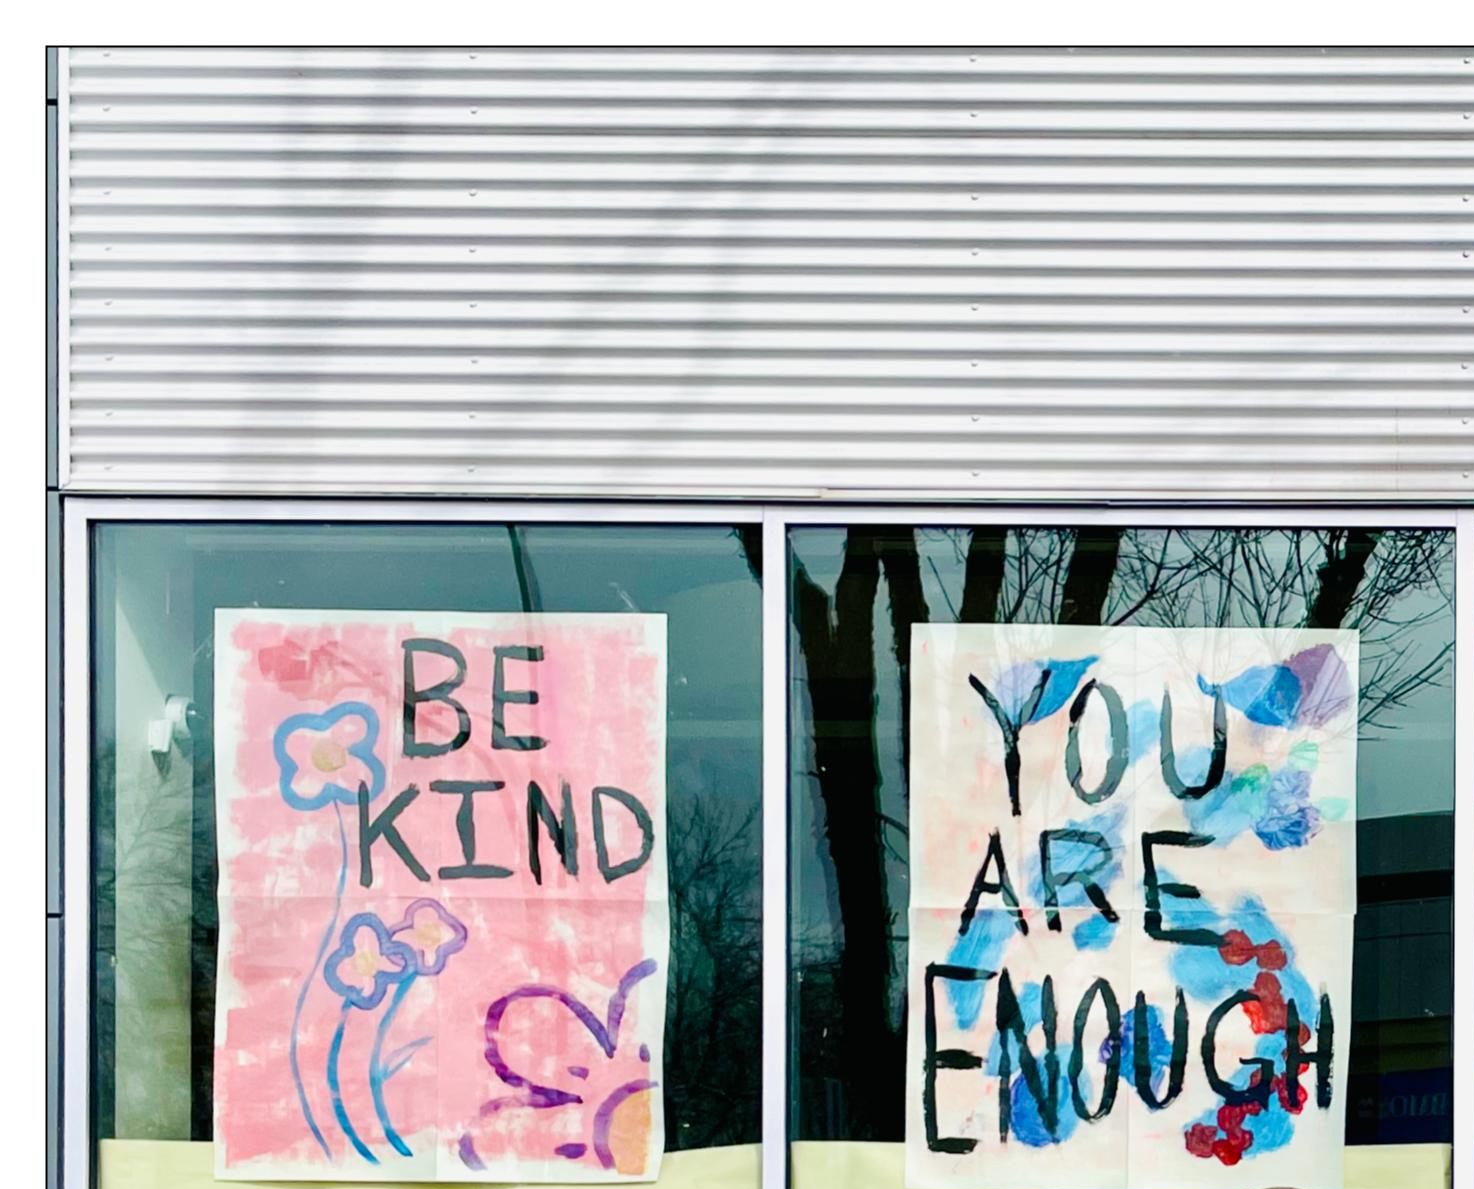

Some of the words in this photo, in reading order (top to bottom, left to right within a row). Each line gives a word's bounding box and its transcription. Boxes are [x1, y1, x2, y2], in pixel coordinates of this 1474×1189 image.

[400, 637, 550, 758] BE
[968, 668, 1229, 818] YOU
[357, 778, 655, 888] KIND
[958, 826, 1230, 947] ARE
[922, 961, 1335, 1154] ENOUGH
